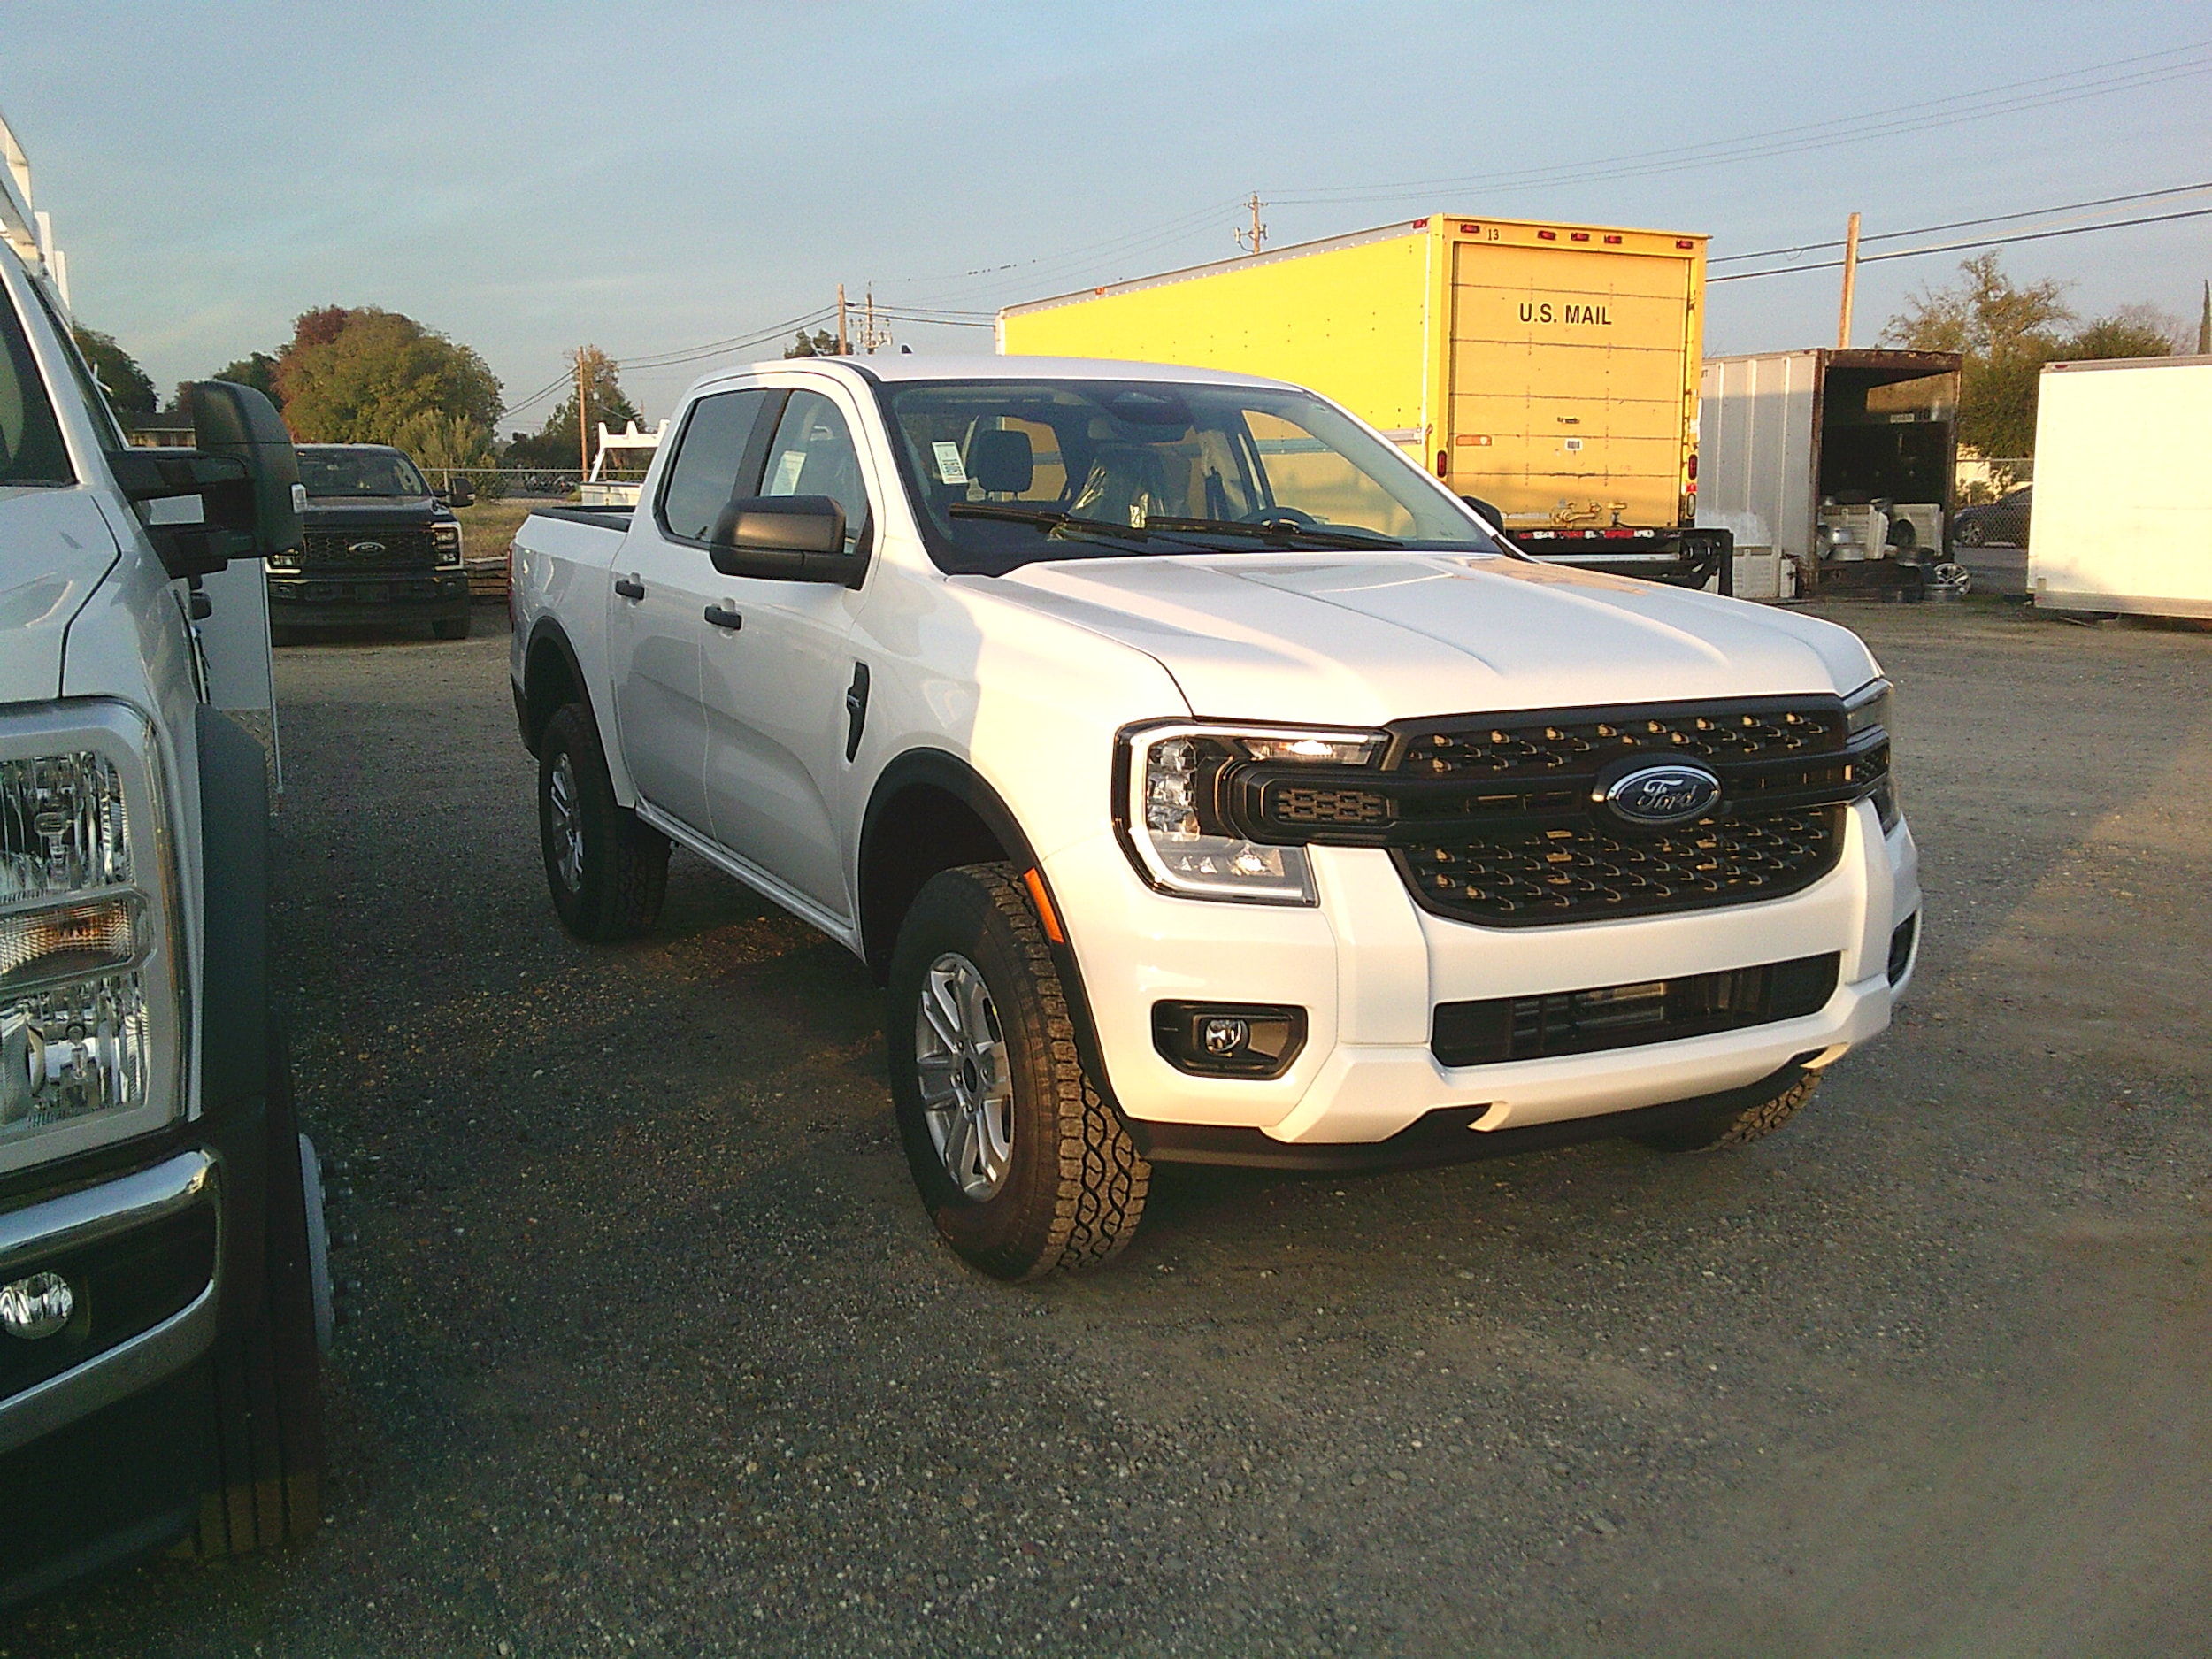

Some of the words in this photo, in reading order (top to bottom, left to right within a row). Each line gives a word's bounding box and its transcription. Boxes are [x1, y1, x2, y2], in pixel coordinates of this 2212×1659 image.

[1487, 228, 1500, 241] 13
[1519, 303, 1557, 323] U.S.
[1565, 305, 1612, 325] MAIL
[1637, 780, 1697, 810] Ford
